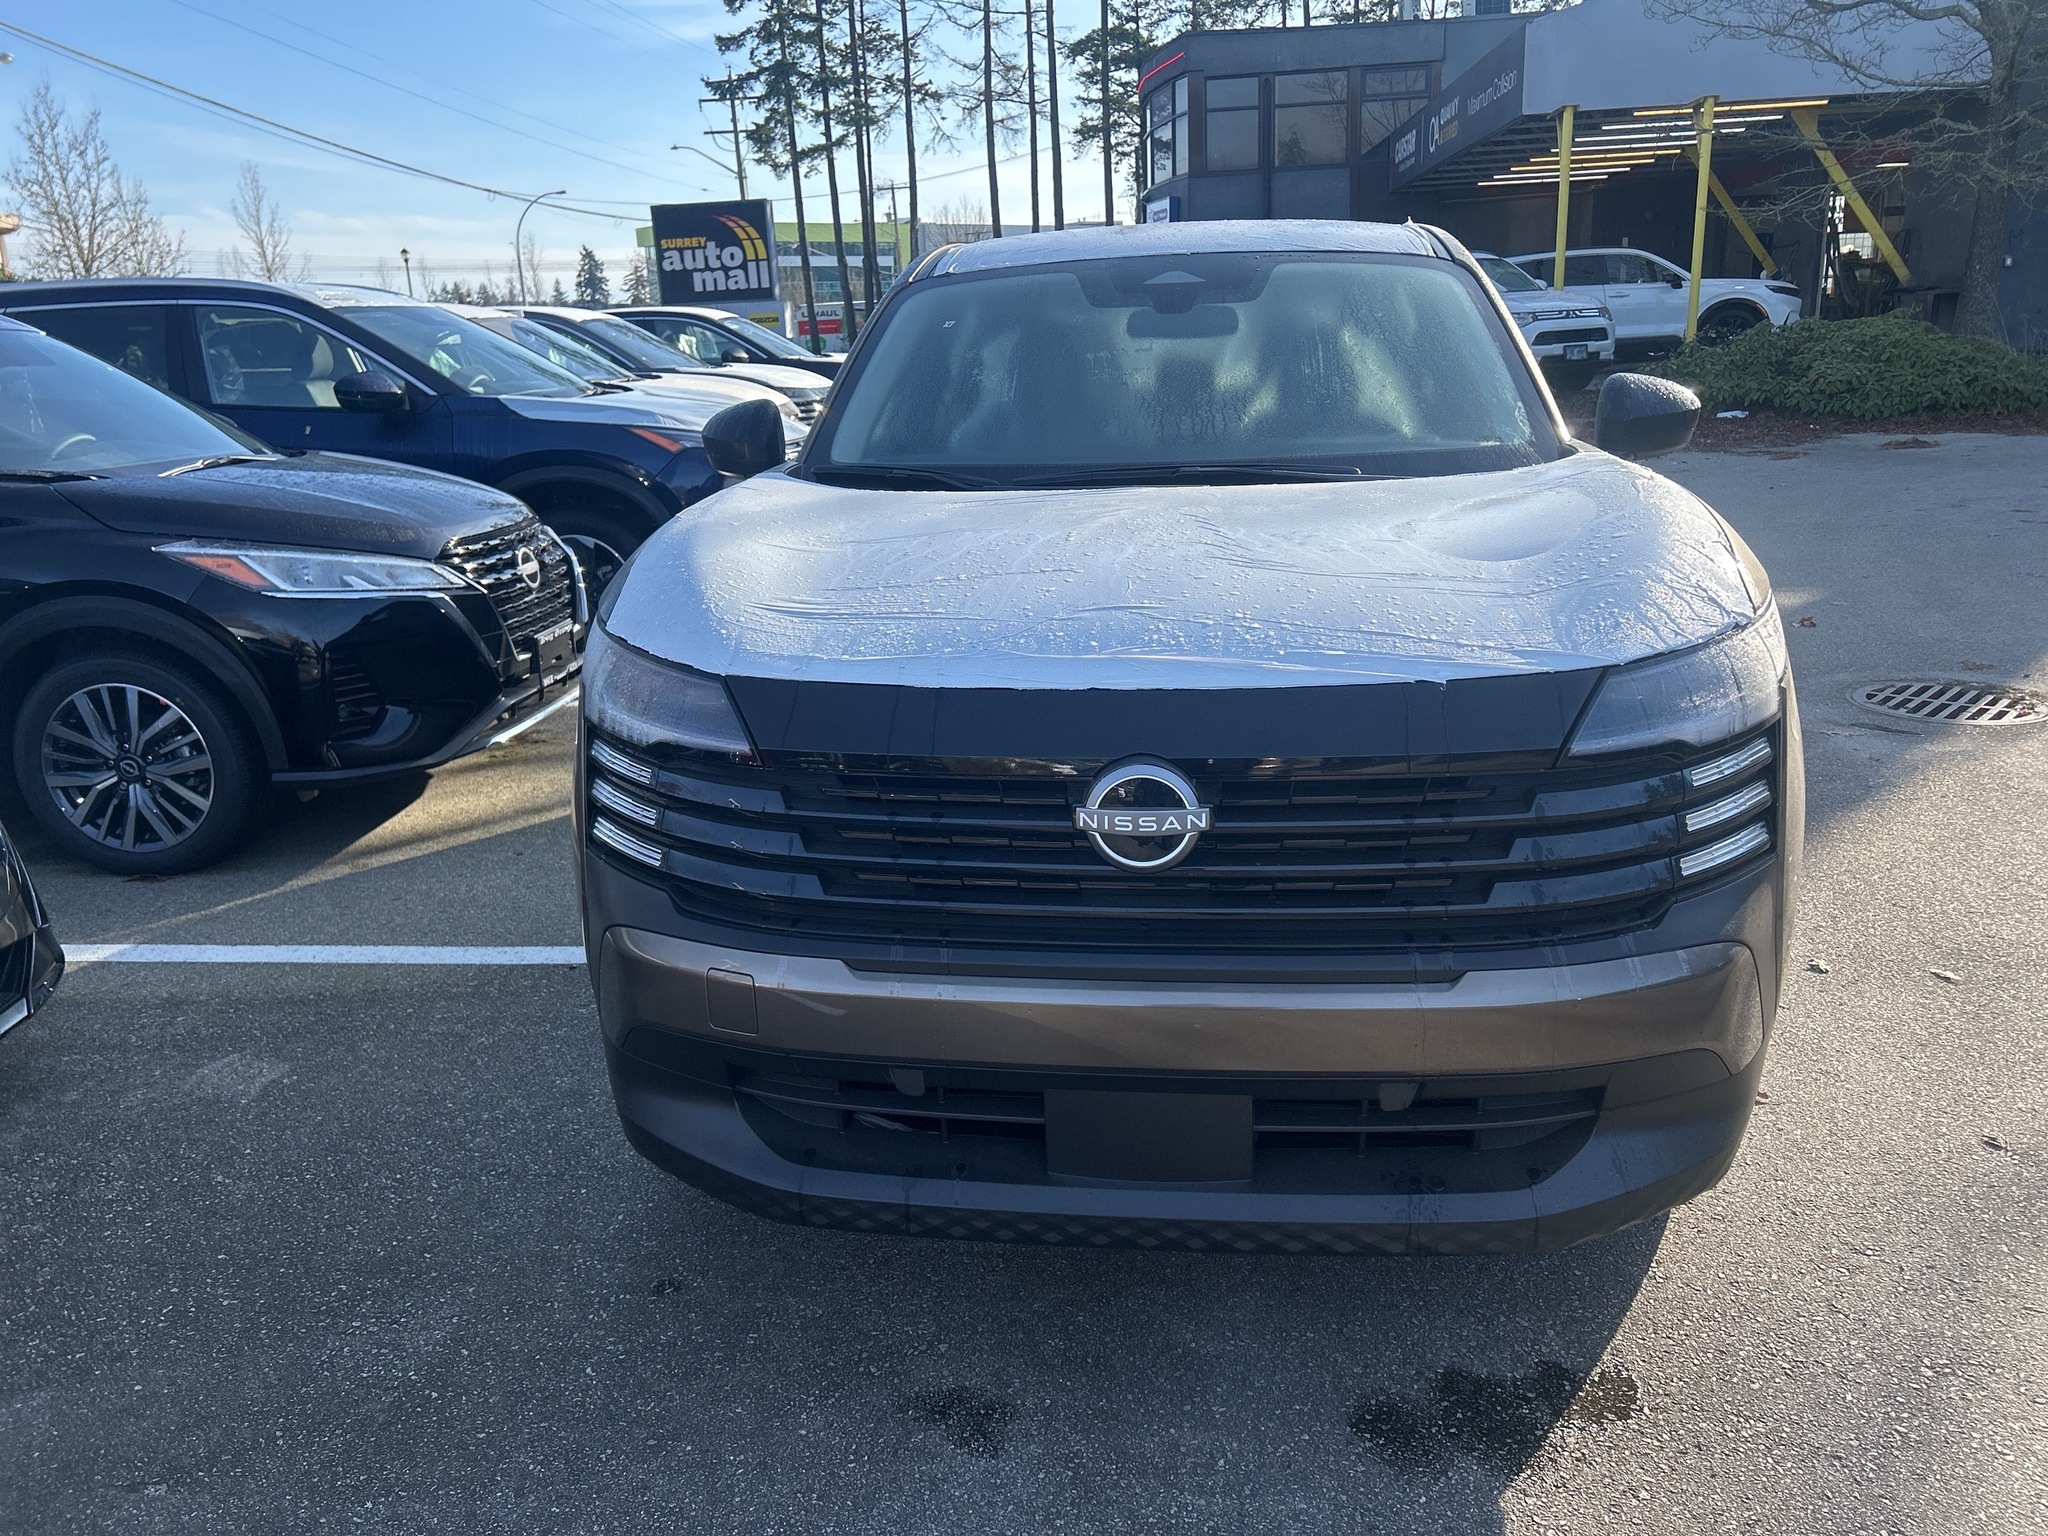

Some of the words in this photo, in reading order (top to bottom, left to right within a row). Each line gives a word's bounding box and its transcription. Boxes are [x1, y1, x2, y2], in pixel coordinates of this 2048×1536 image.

[1467, 87, 1493, 117] Maximum
[1493, 70, 1517, 100] Collision
[660, 237, 707, 249] SURREY
[662, 241, 744, 272] auto
[693, 260, 770, 292] mall
[1079, 812, 1206, 831] NISSAN
